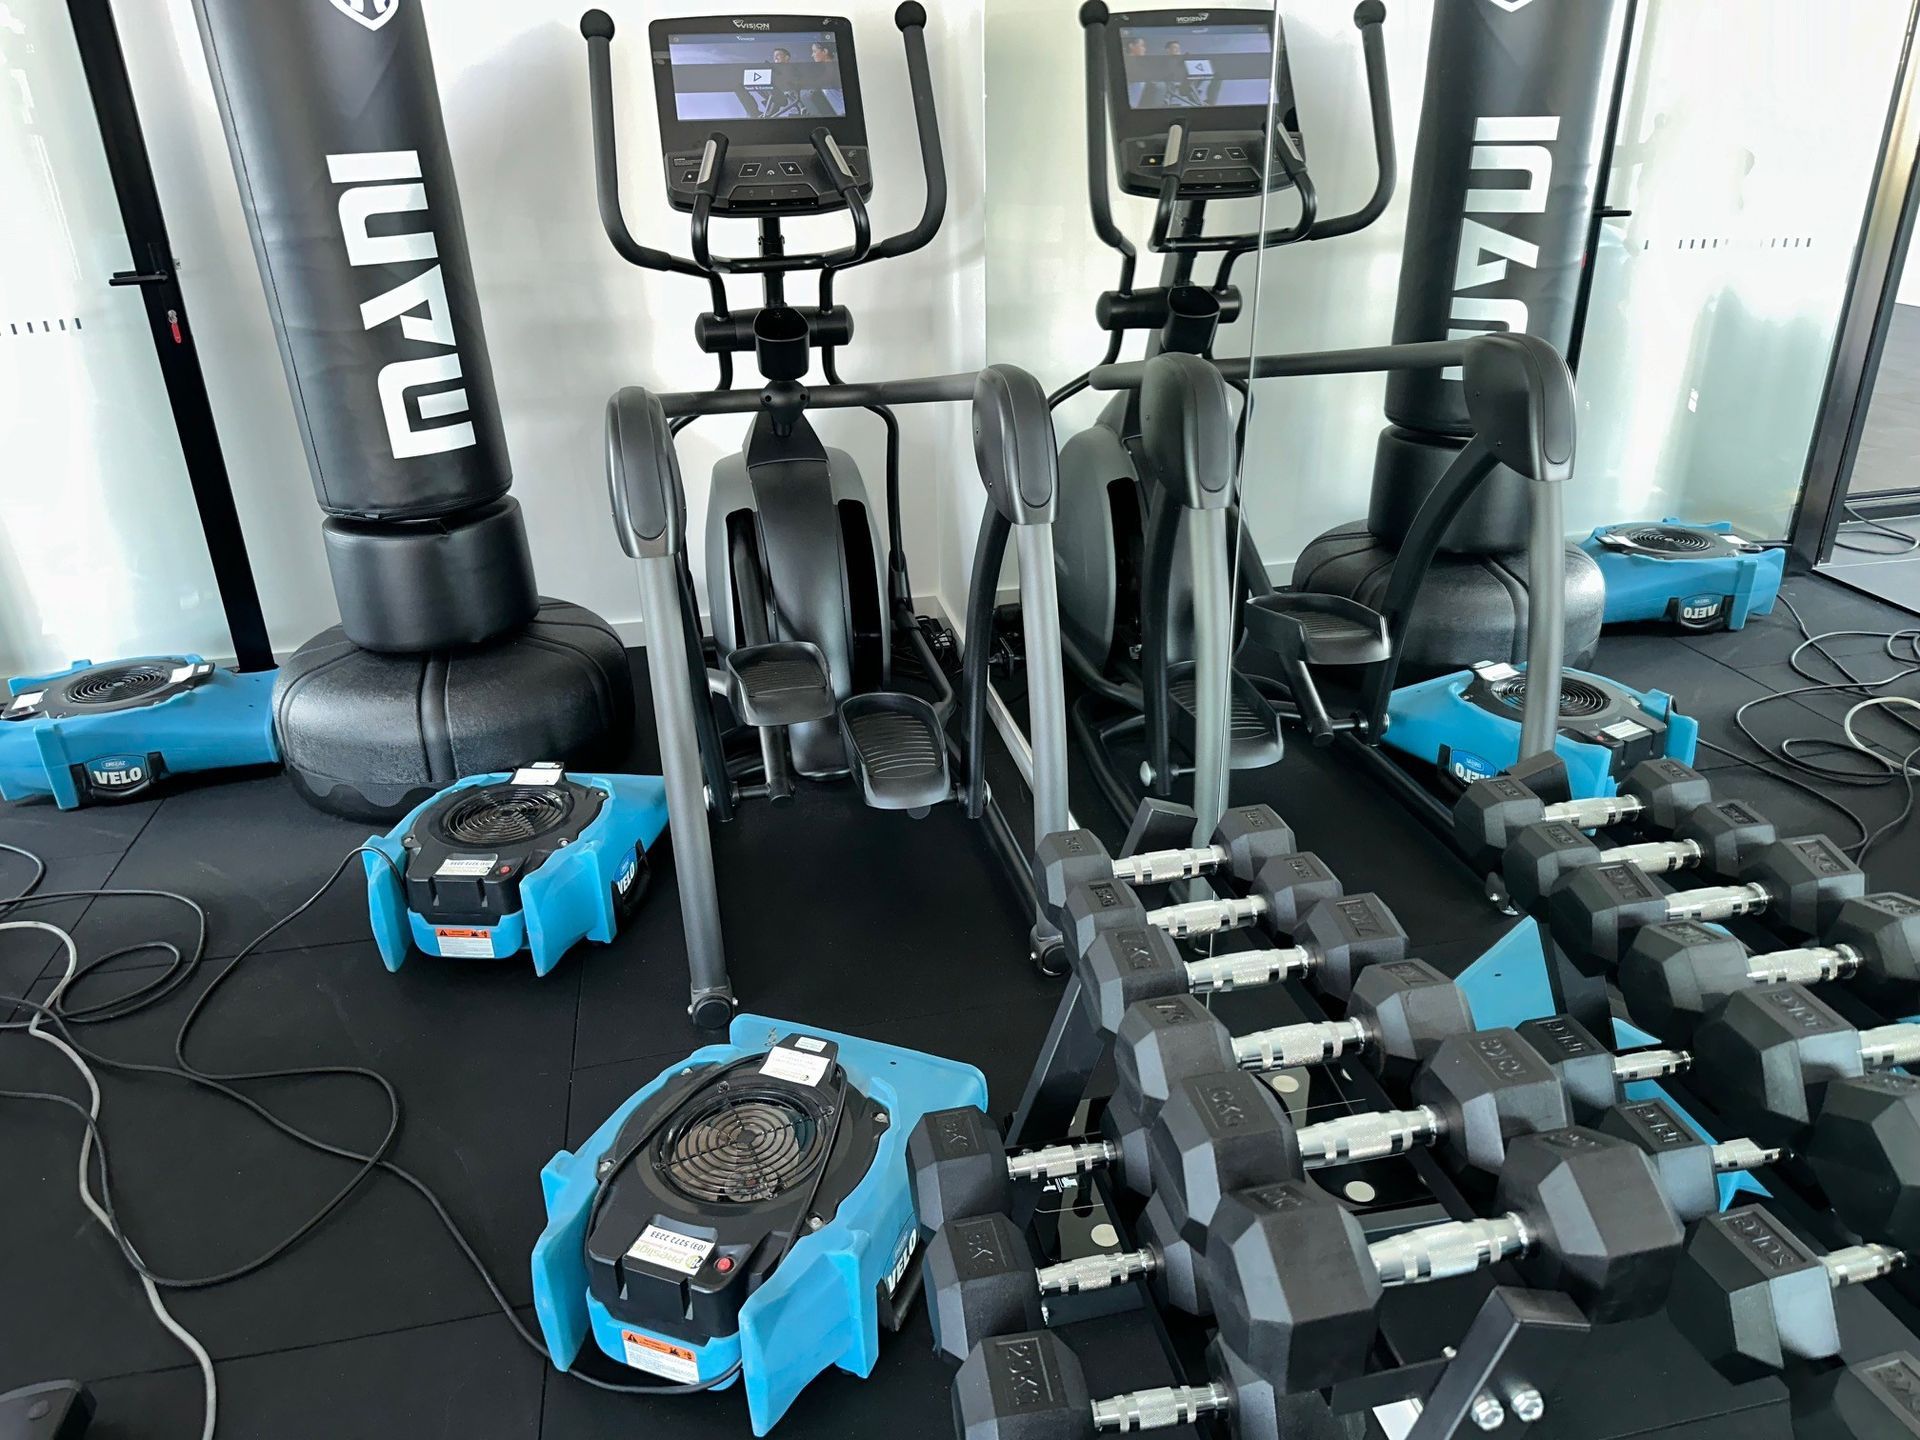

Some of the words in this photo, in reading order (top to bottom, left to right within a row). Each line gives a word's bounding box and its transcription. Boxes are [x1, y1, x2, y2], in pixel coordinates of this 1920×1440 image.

[326, 150, 476, 459] MANI
[93, 767, 142, 785] VELO
[617, 861, 635, 895] VELO
[650, 1231, 668, 1241] 2233
[670, 1236, 688, 1247] 5272
[690, 1242, 707, 1252] (03)
[887, 1228, 917, 1293] VELO
